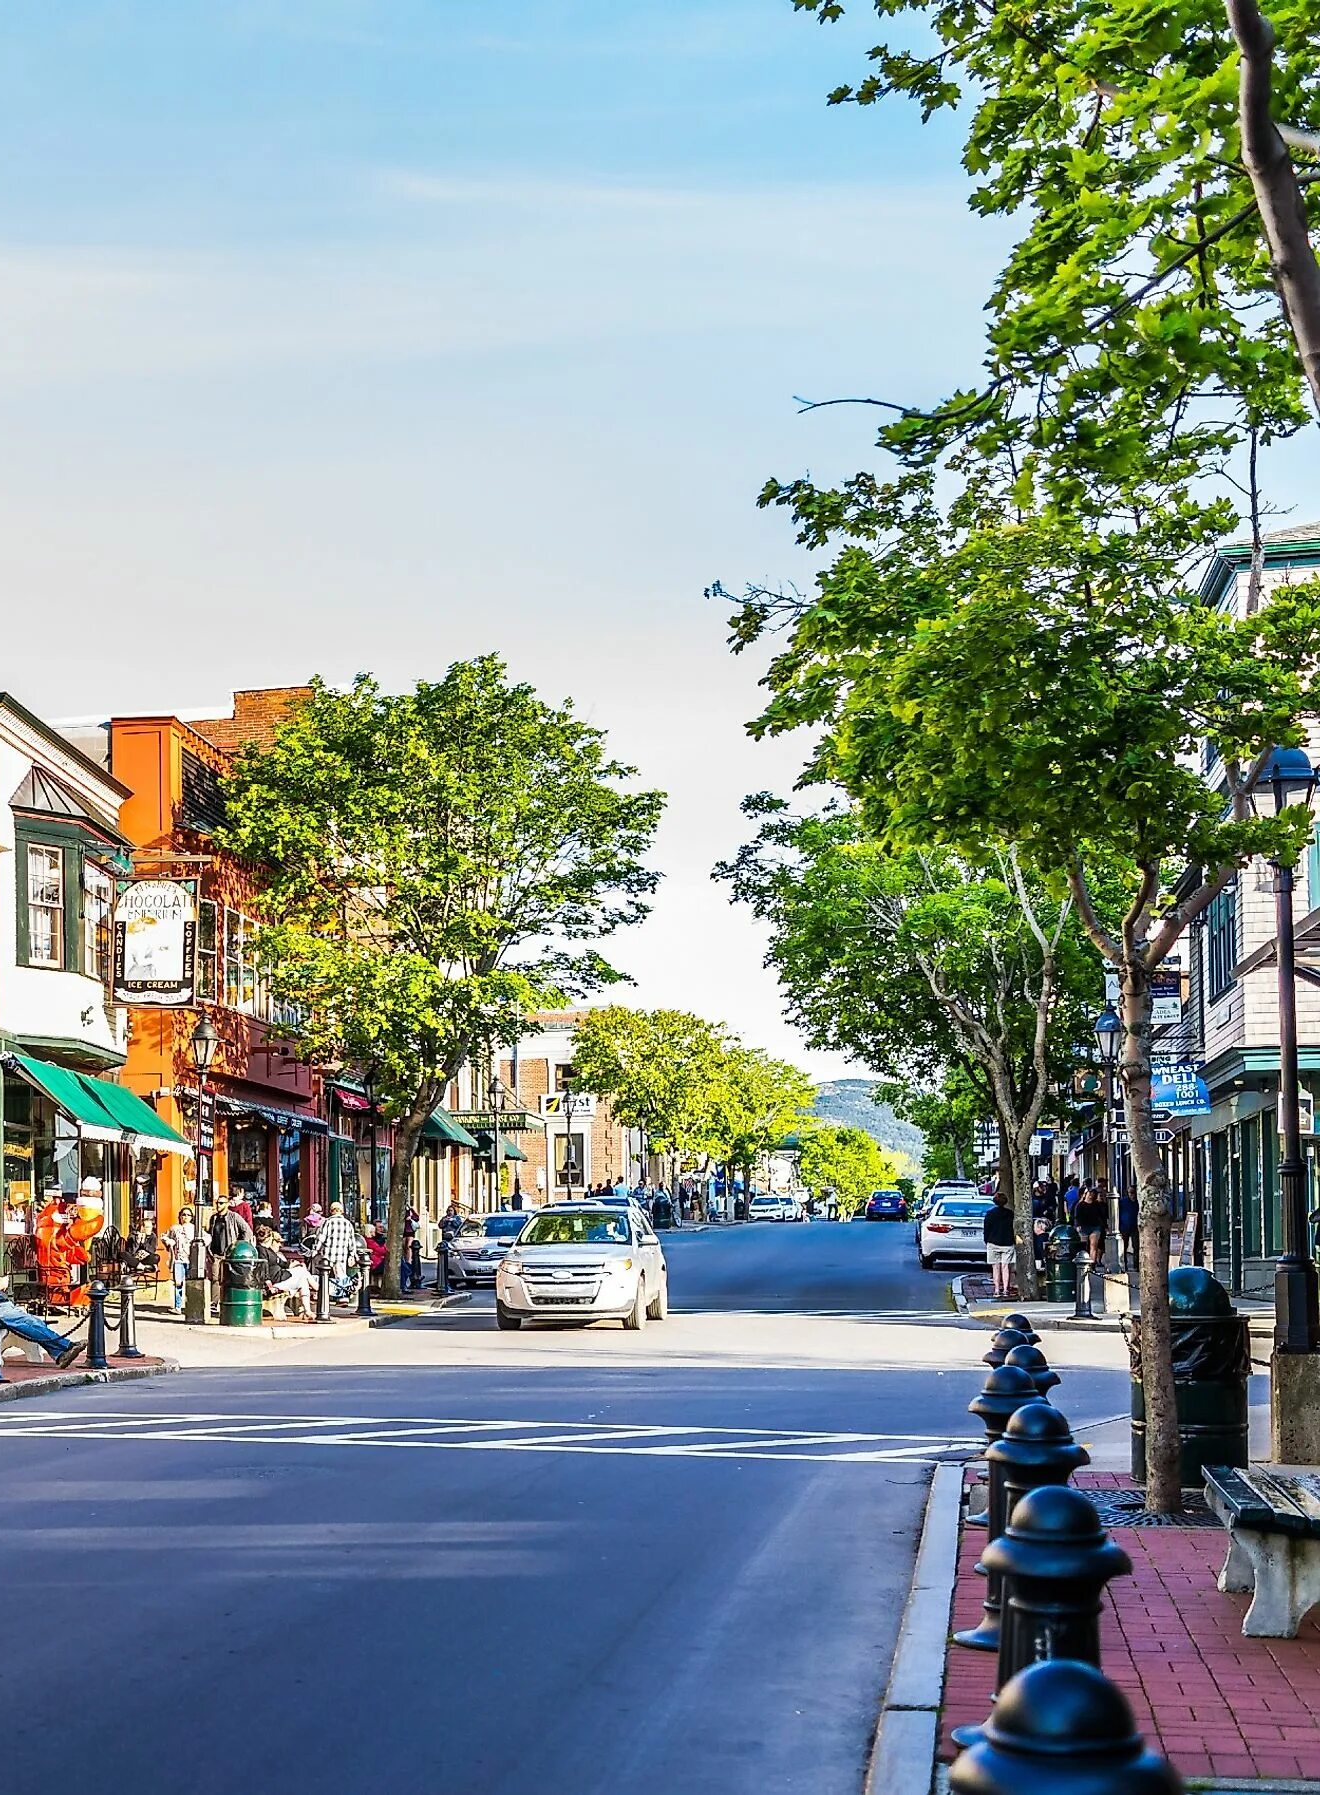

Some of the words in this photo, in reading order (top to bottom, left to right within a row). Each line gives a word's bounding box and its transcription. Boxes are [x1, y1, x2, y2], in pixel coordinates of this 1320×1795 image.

[116, 922, 124, 978] CANDIES
[127, 981, 142, 989] ICE
[146, 981, 178, 989] CREAM
[1162, 1073, 1197, 1085] DELI
[1176, 1090, 1199, 1099] 1001
